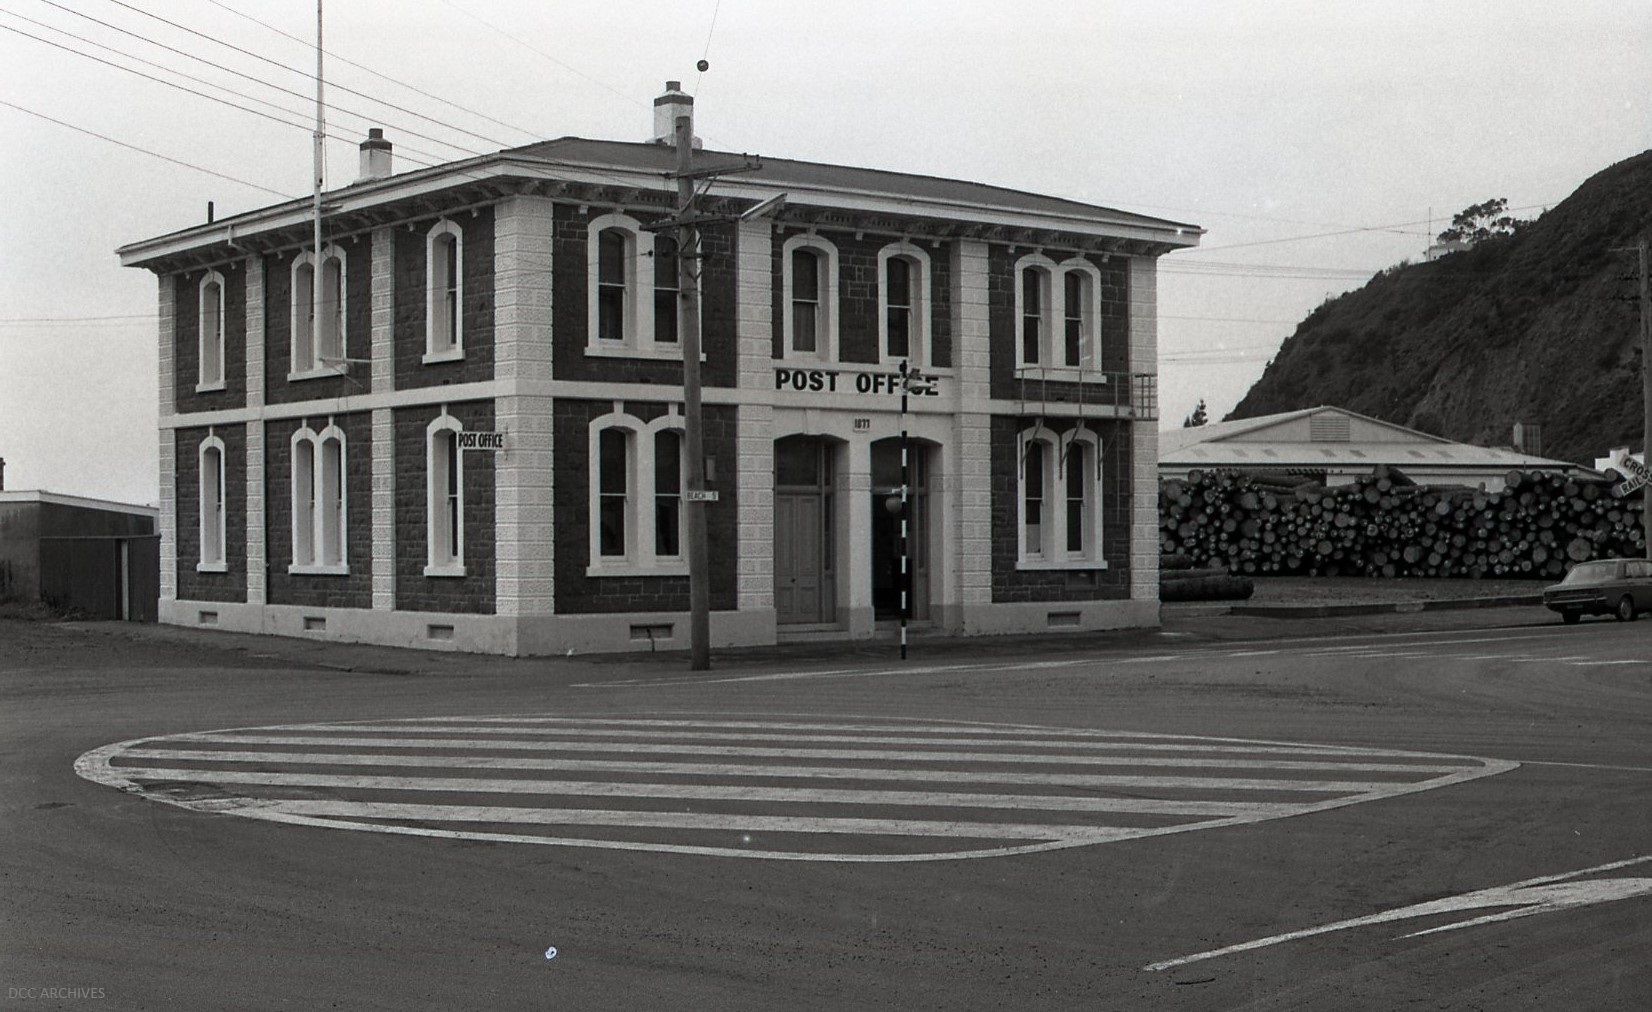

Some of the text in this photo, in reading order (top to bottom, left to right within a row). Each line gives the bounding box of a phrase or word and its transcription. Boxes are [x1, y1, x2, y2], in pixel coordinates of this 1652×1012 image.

[775, 368, 840, 392] POST
[458, 433, 503, 448] POST OFFICE
